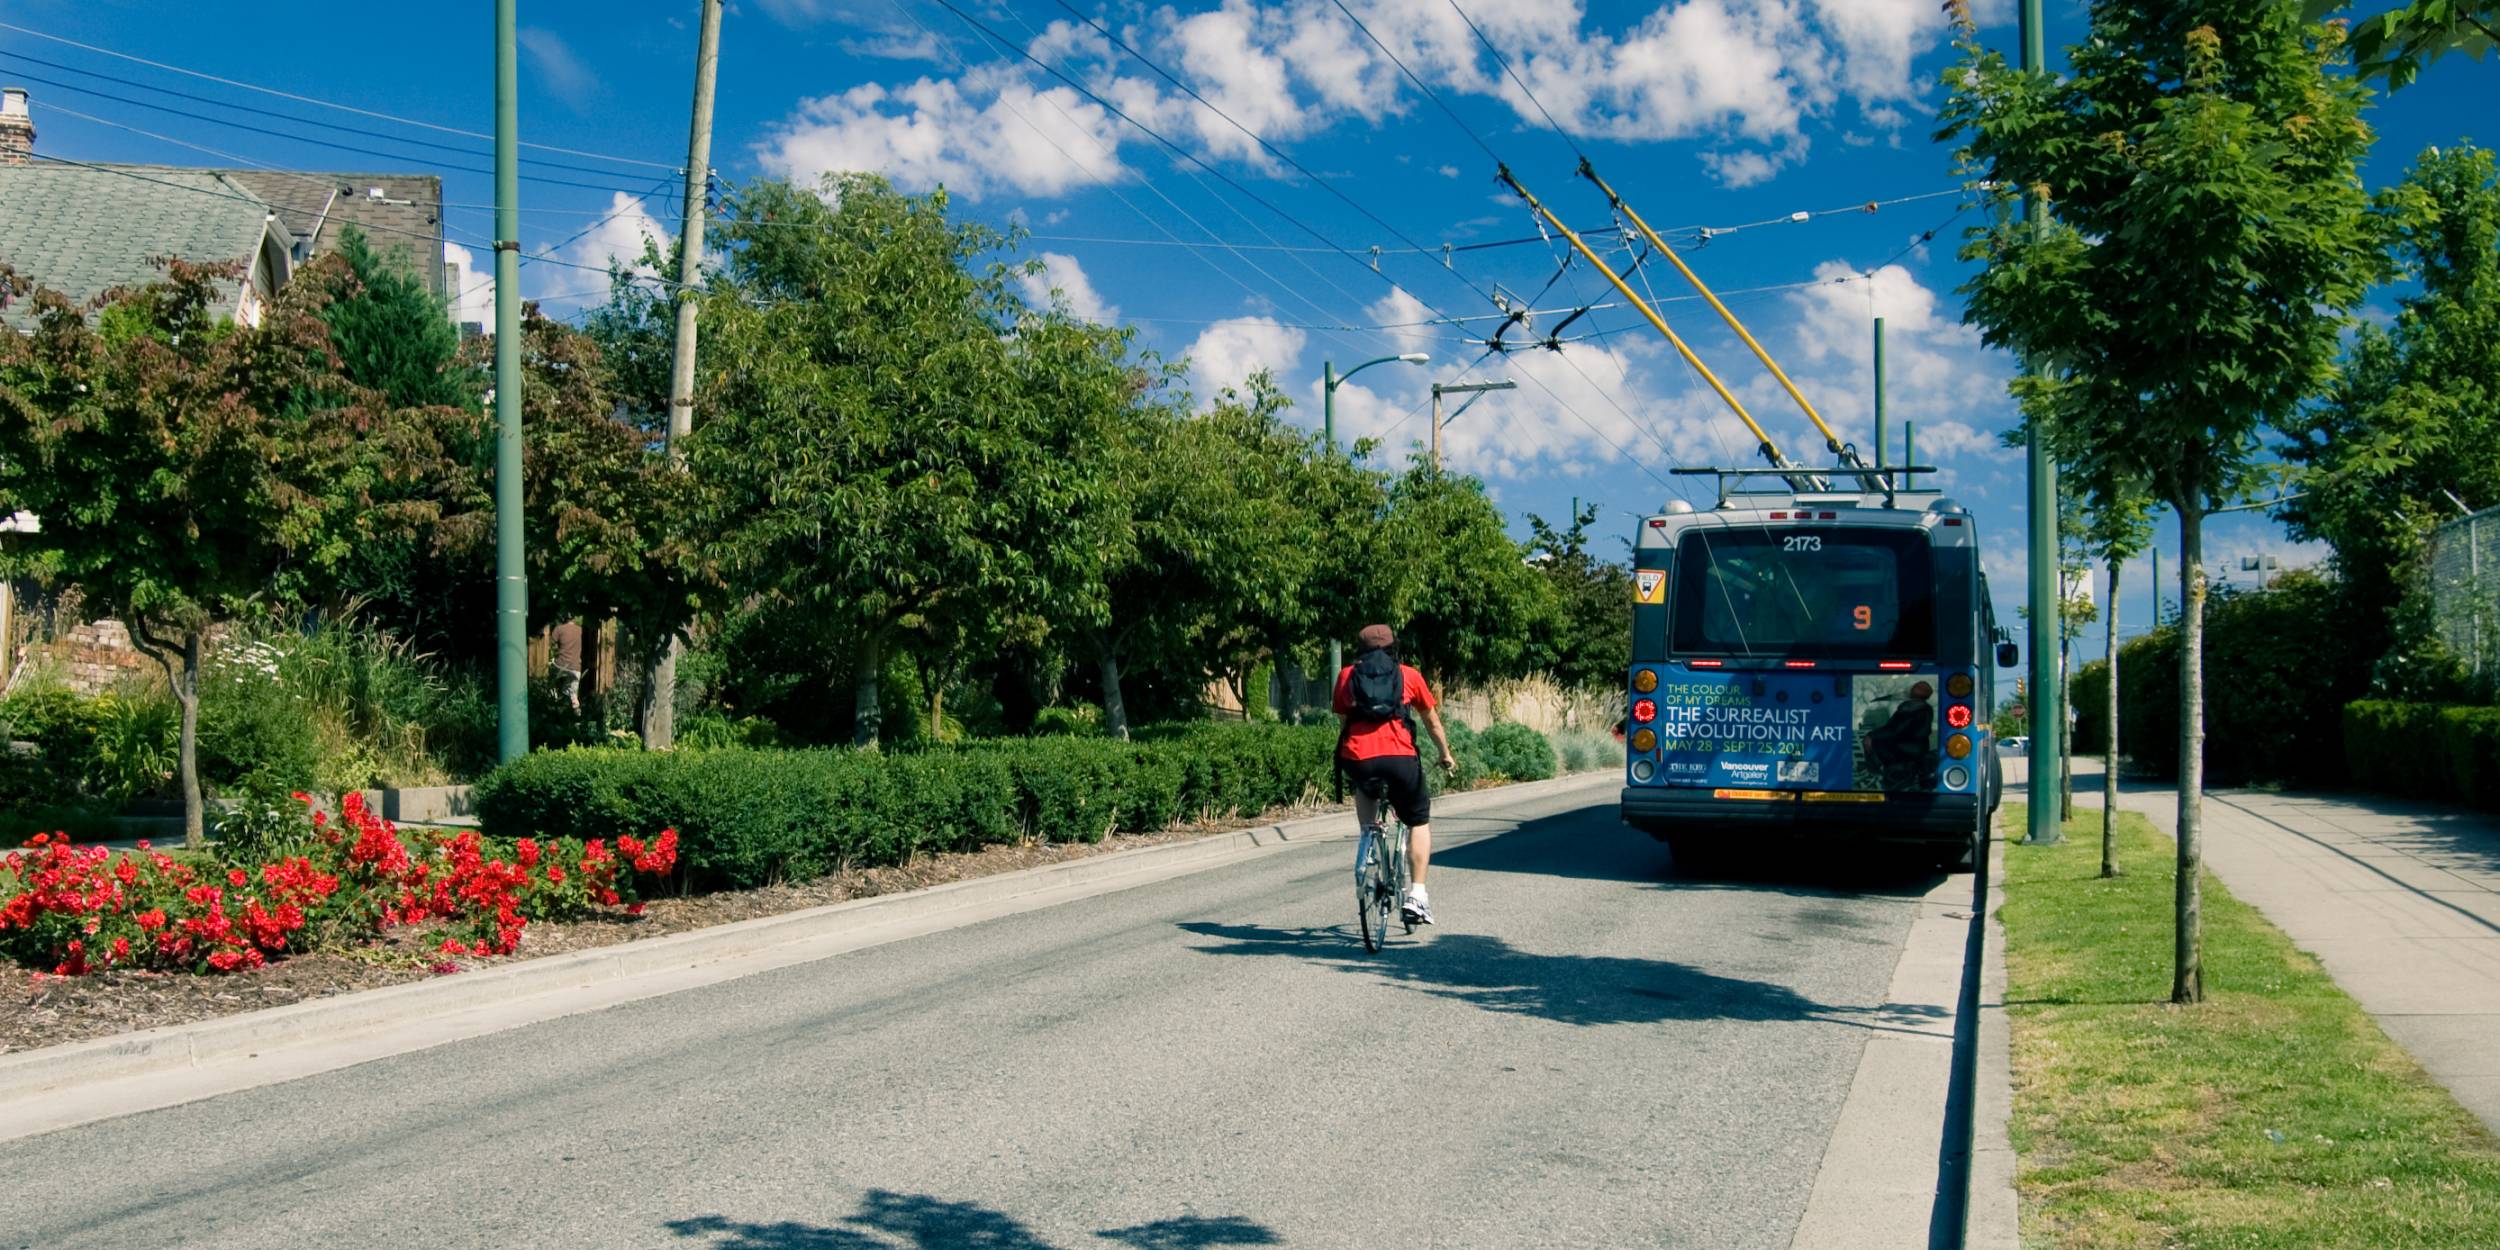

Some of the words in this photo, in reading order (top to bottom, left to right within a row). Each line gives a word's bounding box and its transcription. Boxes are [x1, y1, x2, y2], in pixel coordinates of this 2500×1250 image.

[1783, 535, 1822, 552] 2173
[1853, 604, 1872, 630] 9
[1667, 684, 1689, 695] THE
[1691, 684, 1741, 696] COLOUR
[1666, 695, 1682, 705] OF
[1685, 695, 1701, 706] MY
[1705, 695, 1751, 706] DREAMS
[1667, 706, 1701, 722] THE
[1705, 706, 1811, 725] SURREALIST
[1665, 722, 1781, 740] REVOLUTION
[1786, 725, 1805, 741] IN
[1810, 725, 1847, 741] ART
[1665, 740, 1693, 751] MAY
[1697, 740, 1713, 752] 28
[1723, 741, 1754, 753] SEPT
[1758, 741, 1776, 755] 25,
[1720, 761, 1769, 771] Vancouver
